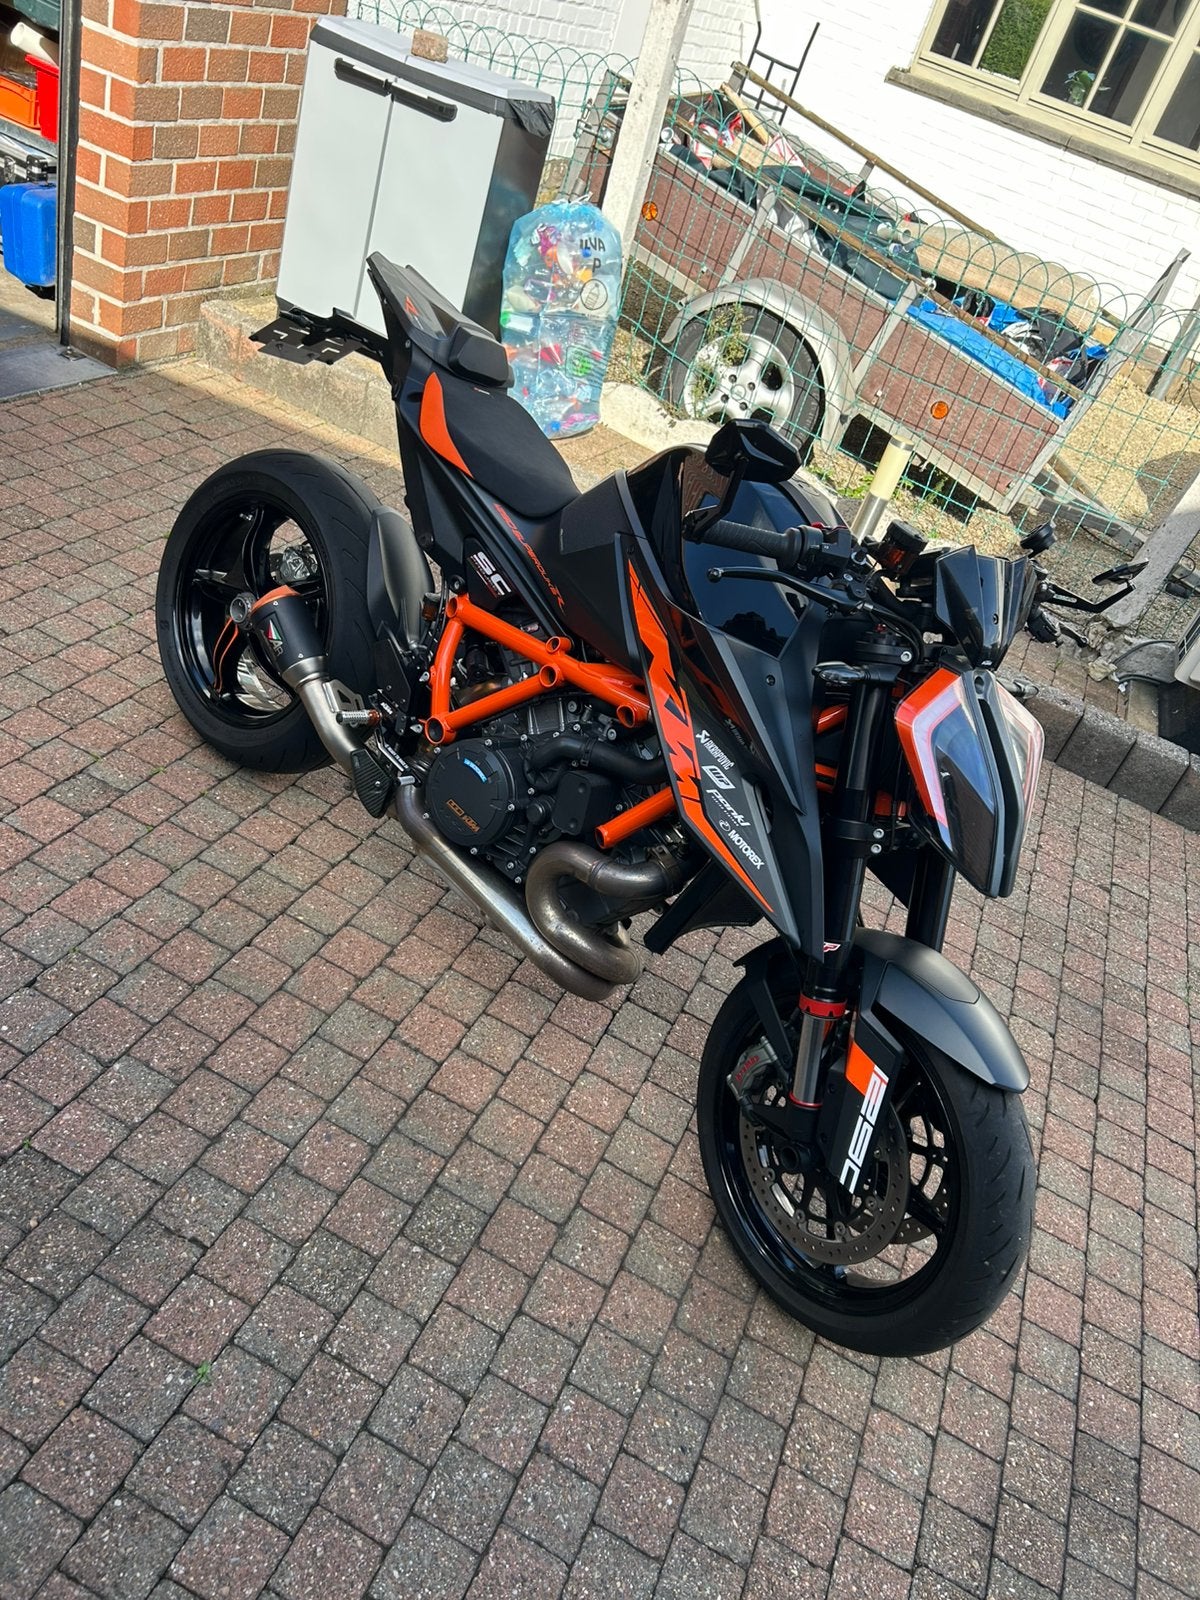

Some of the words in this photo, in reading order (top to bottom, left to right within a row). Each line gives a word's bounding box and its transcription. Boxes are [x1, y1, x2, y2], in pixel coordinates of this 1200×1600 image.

[592, 257, 600, 272] P
[470, 551, 511, 596] SC
[728, 829, 764, 869] MOTOREX
